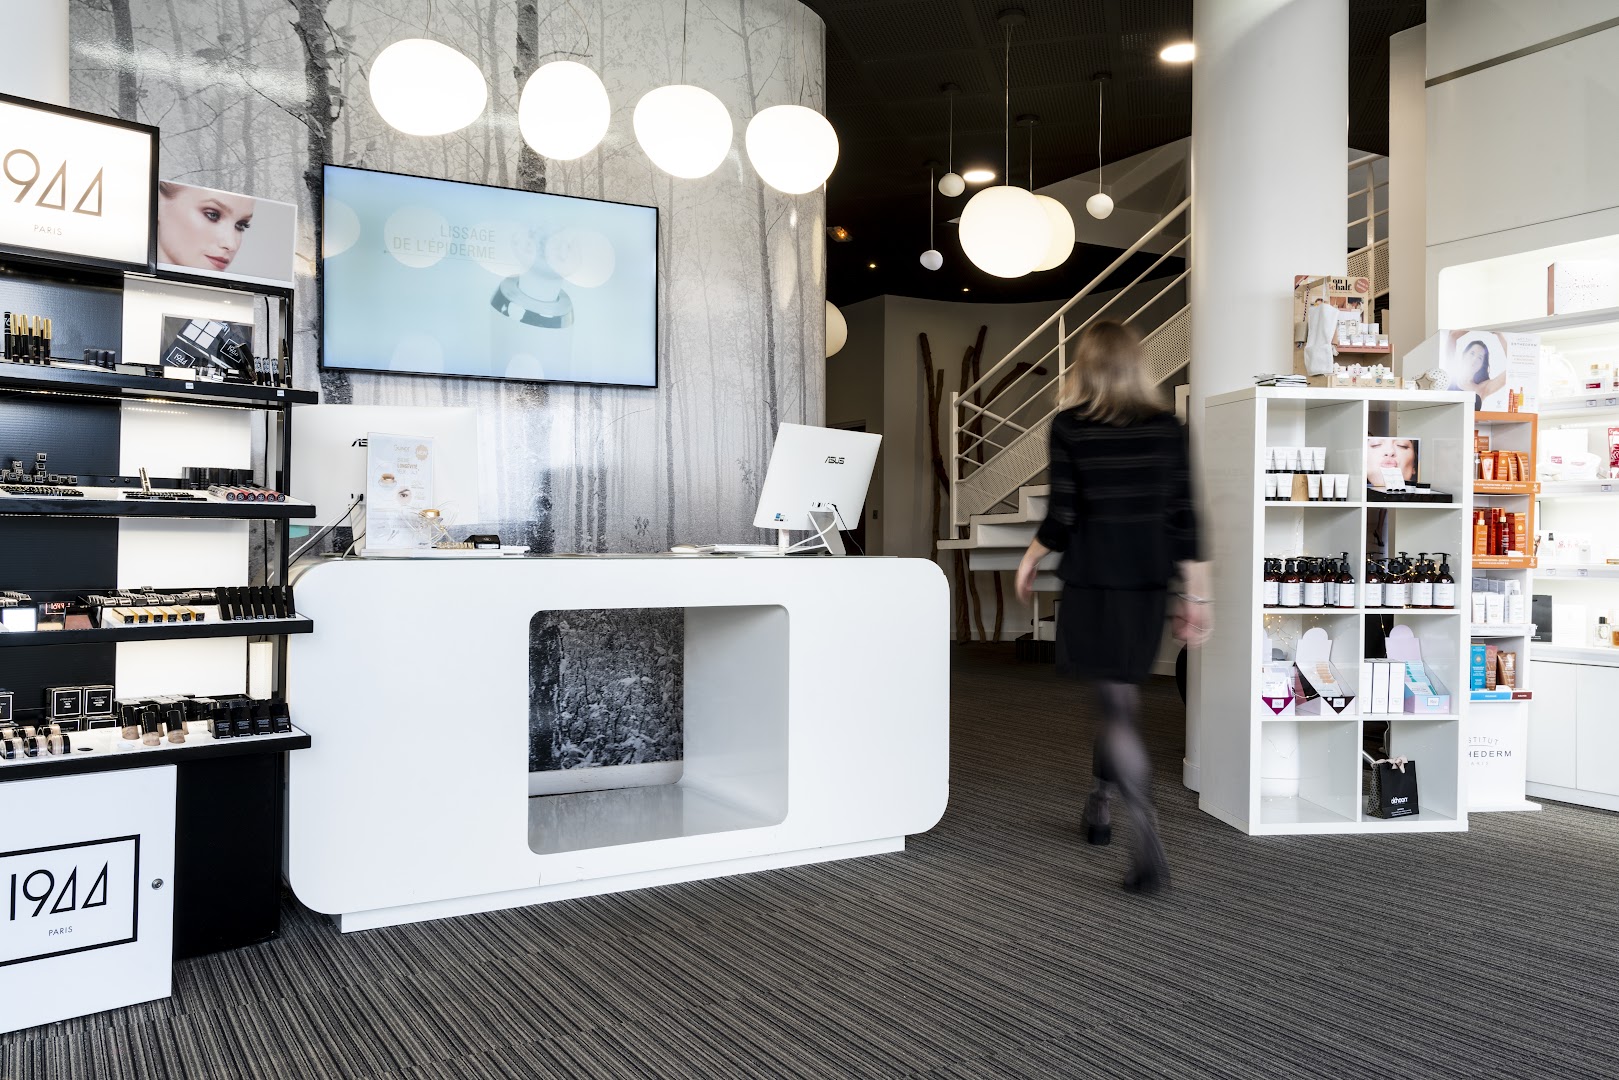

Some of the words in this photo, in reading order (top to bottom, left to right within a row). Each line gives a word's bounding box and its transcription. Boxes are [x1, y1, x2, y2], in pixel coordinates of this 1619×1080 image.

[33, 223, 63, 237] PARIS
[440, 224, 496, 243] LISSAGE
[393, 236, 412, 251] DE
[825, 456, 845, 465] ASUS
[10, 861, 109, 922] 1944
[48, 925, 74, 938] PARIS
